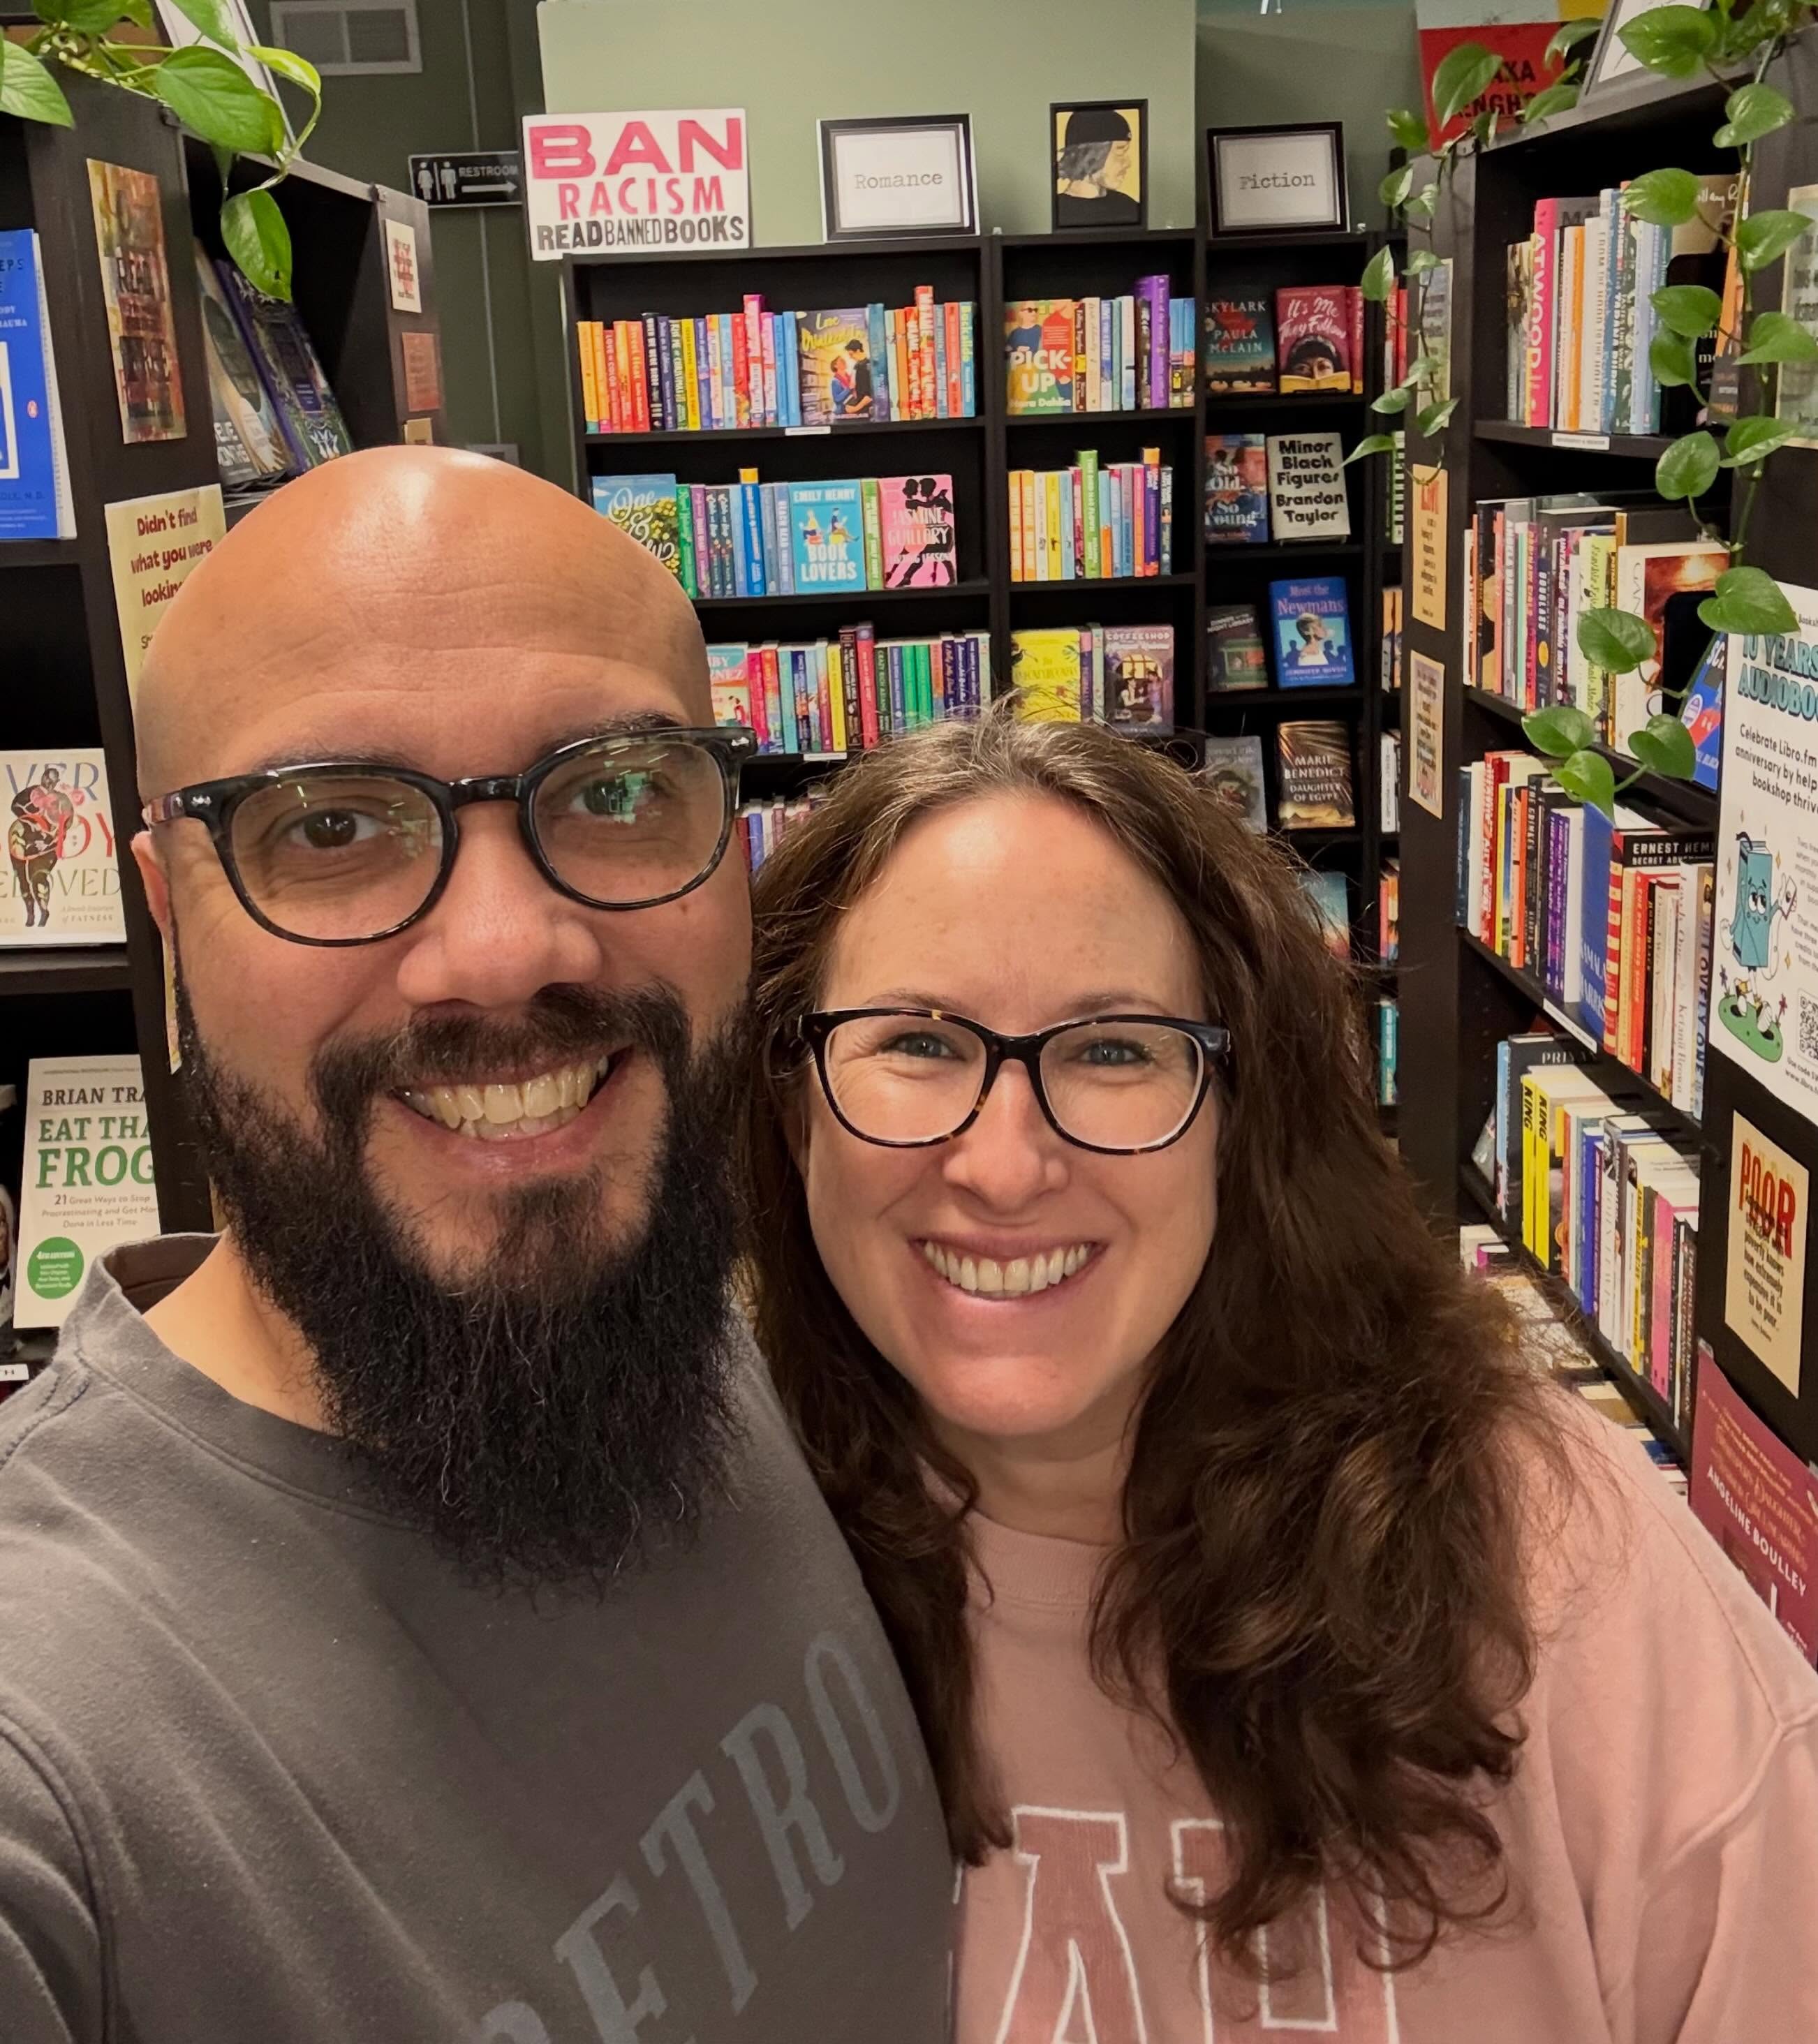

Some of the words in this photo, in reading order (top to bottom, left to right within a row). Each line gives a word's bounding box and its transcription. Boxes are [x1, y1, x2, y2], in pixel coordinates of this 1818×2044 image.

[529, 118, 743, 179] BAN
[854, 172, 943, 190] Romance
[1239, 172, 1316, 191] Fiction
[559, 175, 725, 220] RACISM
[1205, 301, 1267, 313] SKYLARK
[1530, 234, 1547, 369] ATWOOD
[1214, 329, 1258, 340] PAULA
[1010, 350, 1072, 370] PICK-
[1022, 373, 1056, 394] UP
[1278, 440, 1334, 454] Minor
[1282, 454, 1334, 470] Black
[1276, 471, 1340, 489] Figures
[1276, 491, 1344, 508] Brandon
[137, 512, 176, 537] Didn't
[177, 506, 198, 528] find
[1283, 509, 1340, 526] Taylor
[131, 549, 160, 575] what
[162, 546, 186, 571] you
[189, 539, 214, 558] were
[807, 544, 848, 562] BOOK
[801, 562, 857, 583] LOVERS
[1278, 598, 1345, 616] Newmans
[1738, 662, 1818, 722] AUDIOBO
[1740, 723, 1778, 753] Celebrate
[1779, 740, 1817, 768] Libro.fm
[1285, 768, 1345, 780] BENEDICT
[1736, 746, 1781, 775] anniversary
[1783, 762, 1795, 786] by
[1752, 770, 1791, 807] bookshop
[1633, 842, 1679, 854] ERNEST
[1632, 856, 1663, 865] SECRET
[42, 1087, 105, 1106] BRIAN
[1523, 1086, 1534, 1132] KING
[1538, 1095, 1549, 1142] KING
[38, 1118, 91, 1143] EAT
[35, 1145, 155, 1189] FROG
[54, 1194, 67, 1206] 21
[69, 1197, 92, 1205] Great
[95, 1195, 117, 1206] Ways
[131, 1194, 151, 1204] Stop
[42, 1208, 103, 1220] Procrastinating
[106, 1208, 120, 1216] and
[122, 1207, 138, 1216] Get
[63, 1220, 84, 1229] Done
[96, 1218, 114, 1227] Less
[117, 1216, 138, 1226] Time
[1707, 1464, 1751, 1535] ANGELINE
[1752, 1527, 1807, 1597] BOULLEY
[480, 1630, 925, 2044] ETRO
